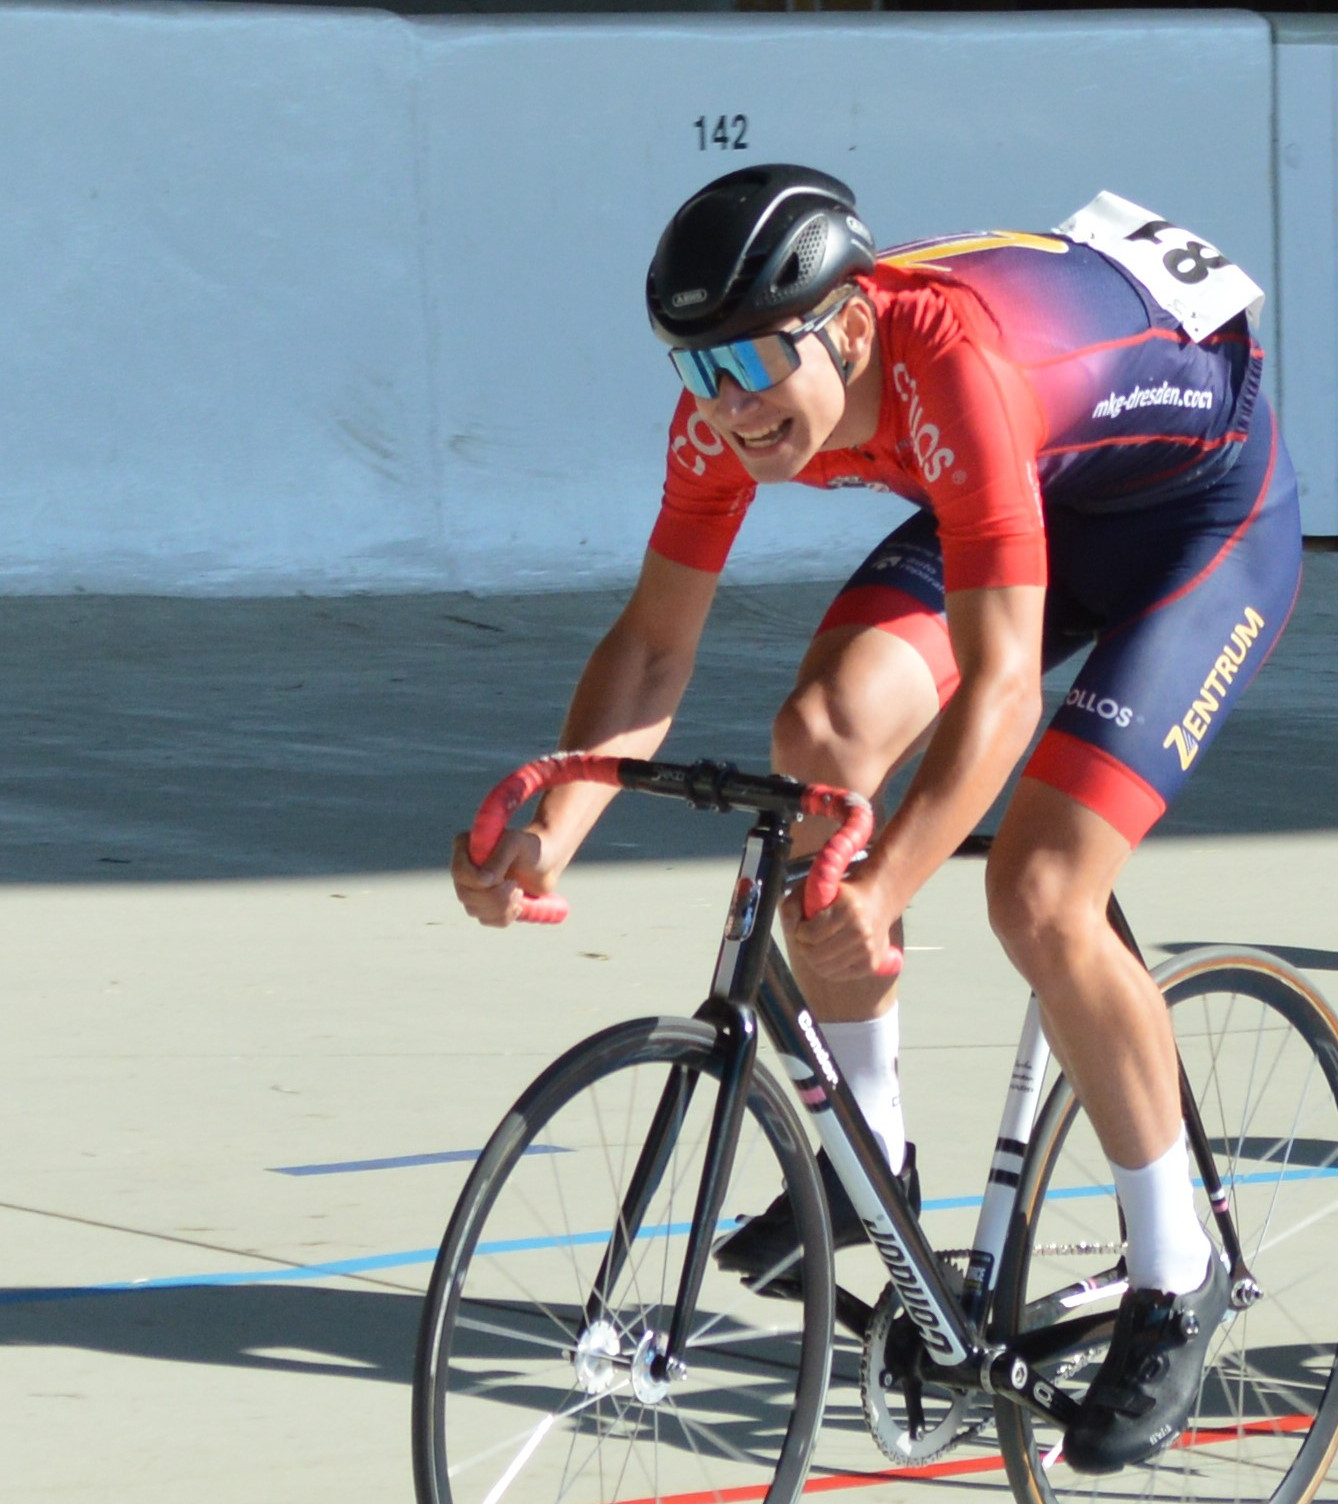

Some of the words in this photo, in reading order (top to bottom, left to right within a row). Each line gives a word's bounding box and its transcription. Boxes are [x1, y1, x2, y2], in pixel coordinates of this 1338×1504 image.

[693, 113, 749, 151] 142
[1091, 379, 1214, 420] mkg-dresden.com
[1162, 606, 1266, 772] ZENTRUM
[797, 1009, 839, 1085] Condor
